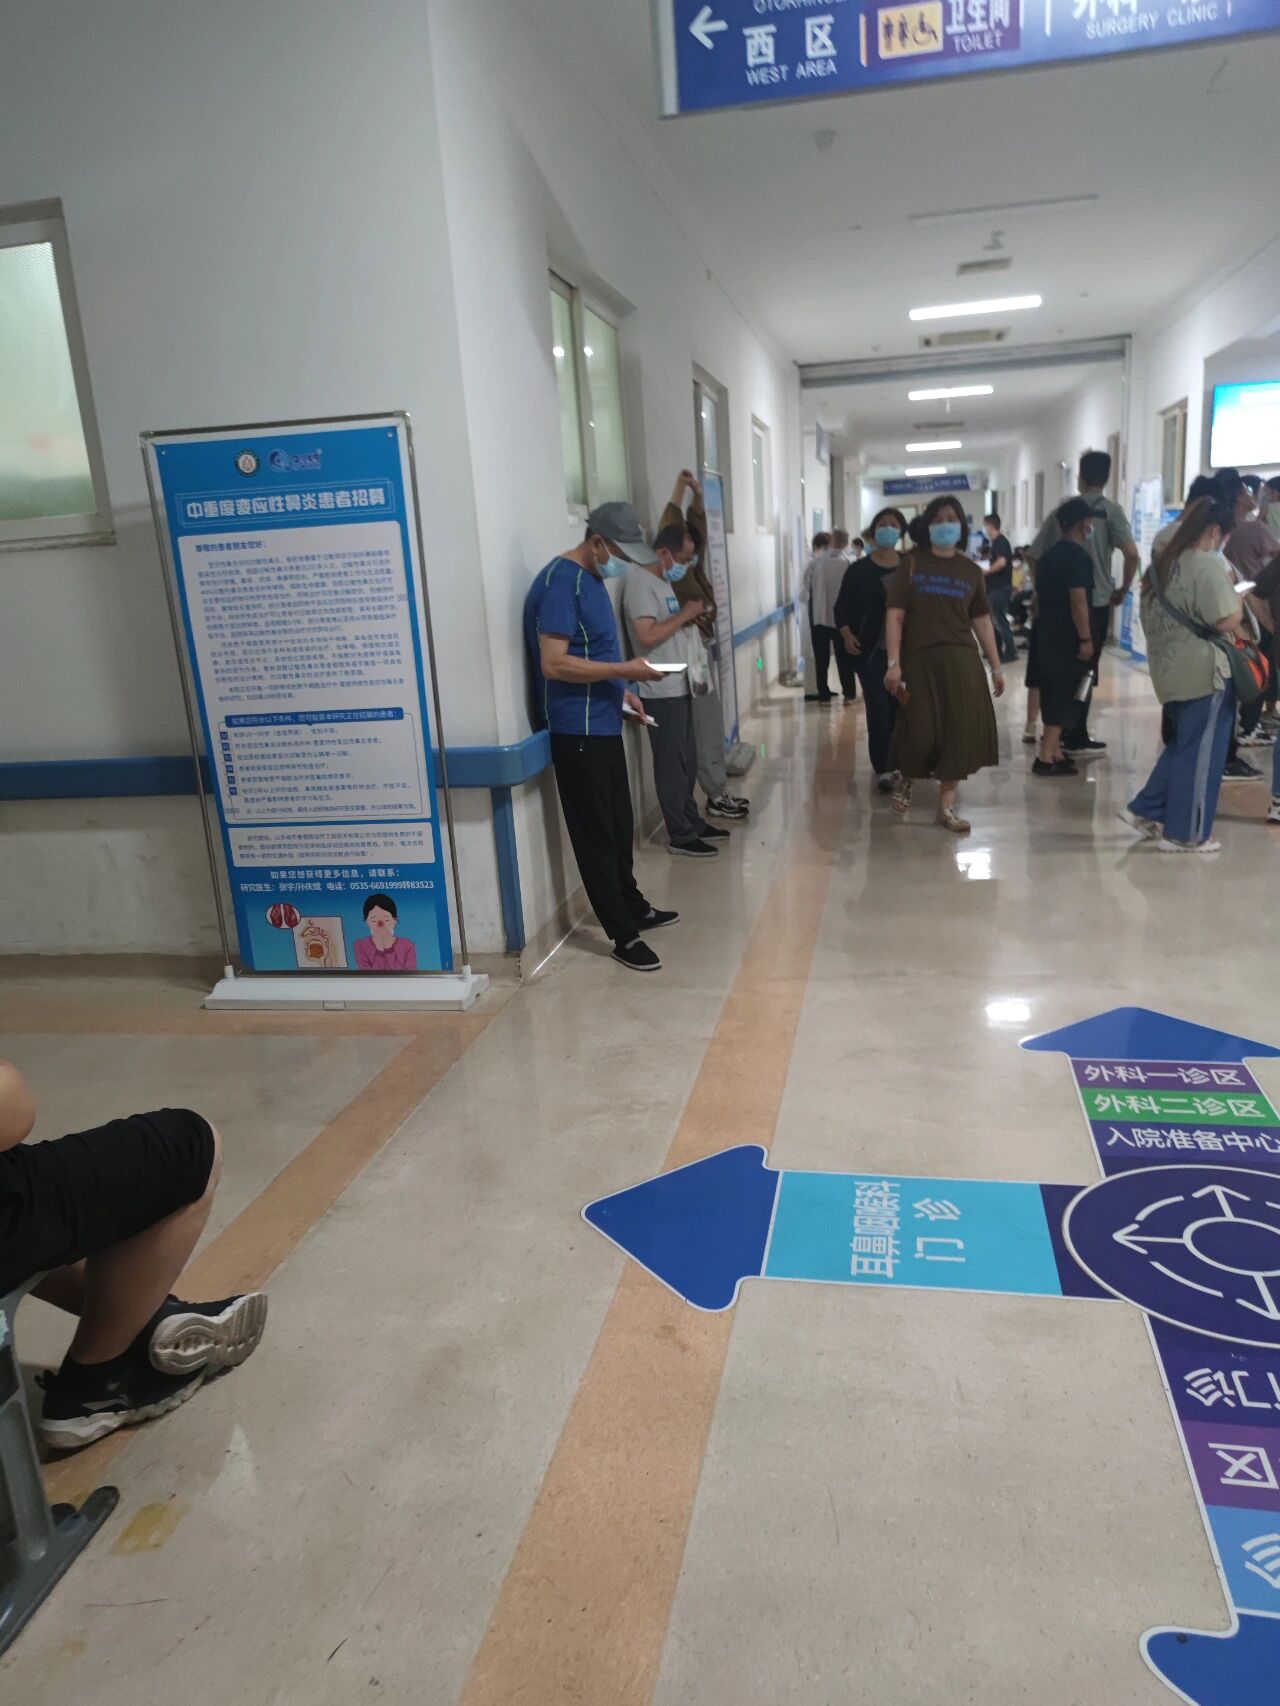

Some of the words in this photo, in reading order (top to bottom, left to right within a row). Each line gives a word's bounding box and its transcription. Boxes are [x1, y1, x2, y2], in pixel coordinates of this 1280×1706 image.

[1086, 12, 1159, 39] SURGERY
[1167, 3, 1218, 27] CLINIC
[953, 30, 1003, 52] TOILET
[746, 65, 789, 86] WEST
[796, 58, 837, 80] AREA
[187, 488, 385, 518] 中重度变应性鼻炎患者招募
[1084, 1065, 1246, 1086] 外科一诊区
[1094, 1093, 1266, 1118] 外科二诊区
[1106, 1126, 1280, 1153] 入院准备中心
[850, 1181, 900, 1278] 耳鼻咽喉科
[912, 1198, 966, 1262] 门诊
